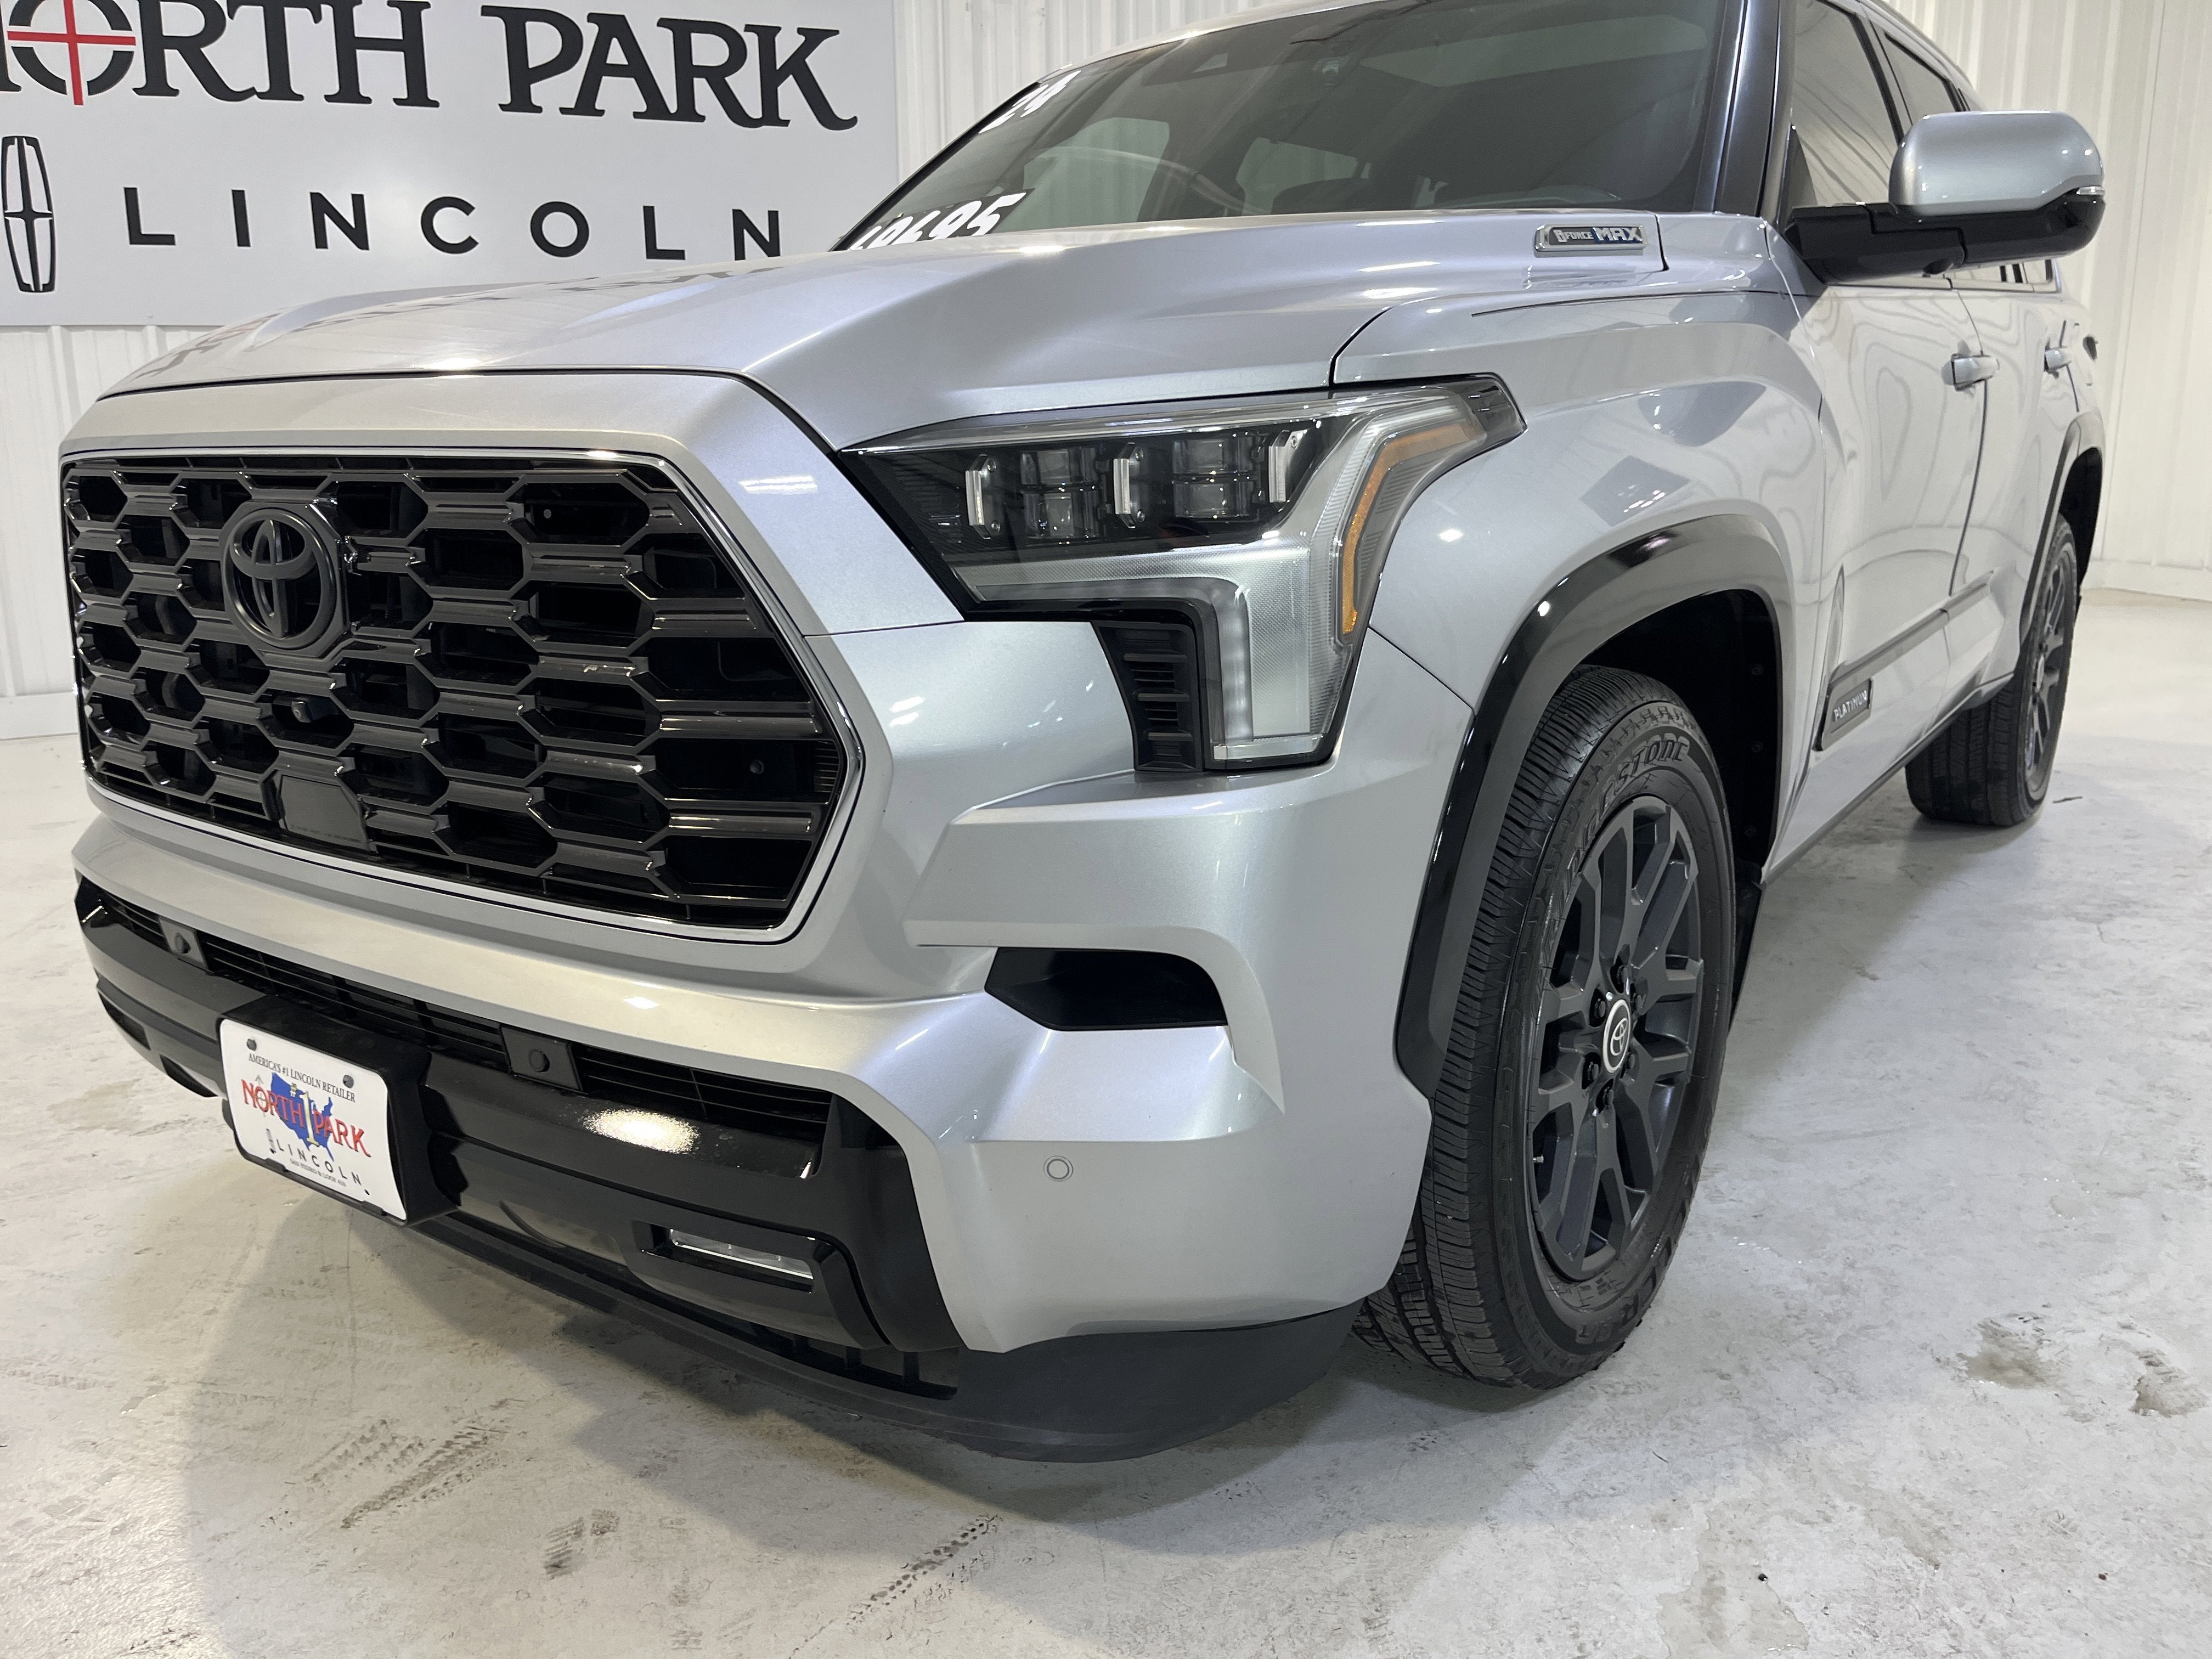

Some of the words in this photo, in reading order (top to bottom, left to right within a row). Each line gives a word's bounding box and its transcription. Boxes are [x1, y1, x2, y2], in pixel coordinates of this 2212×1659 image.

[0, 0, 441, 108] ORTH
[481, 5, 858, 131] PARK
[123, 187, 781, 261] LINCOLN
[1593, 227, 1643, 241] MAX
[1833, 690, 1867, 721] PLATINUM
[248, 1052, 281, 1073] AMERICA'S
[282, 1064, 289, 1076] #1
[290, 1069, 321, 1089] LINCOLN
[322, 1081, 356, 1103] RETAILER
[241, 1079, 304, 1128] NORTH
[313, 1109, 371, 1158] PARK
[276, 1138, 362, 1186] LINCOLN
